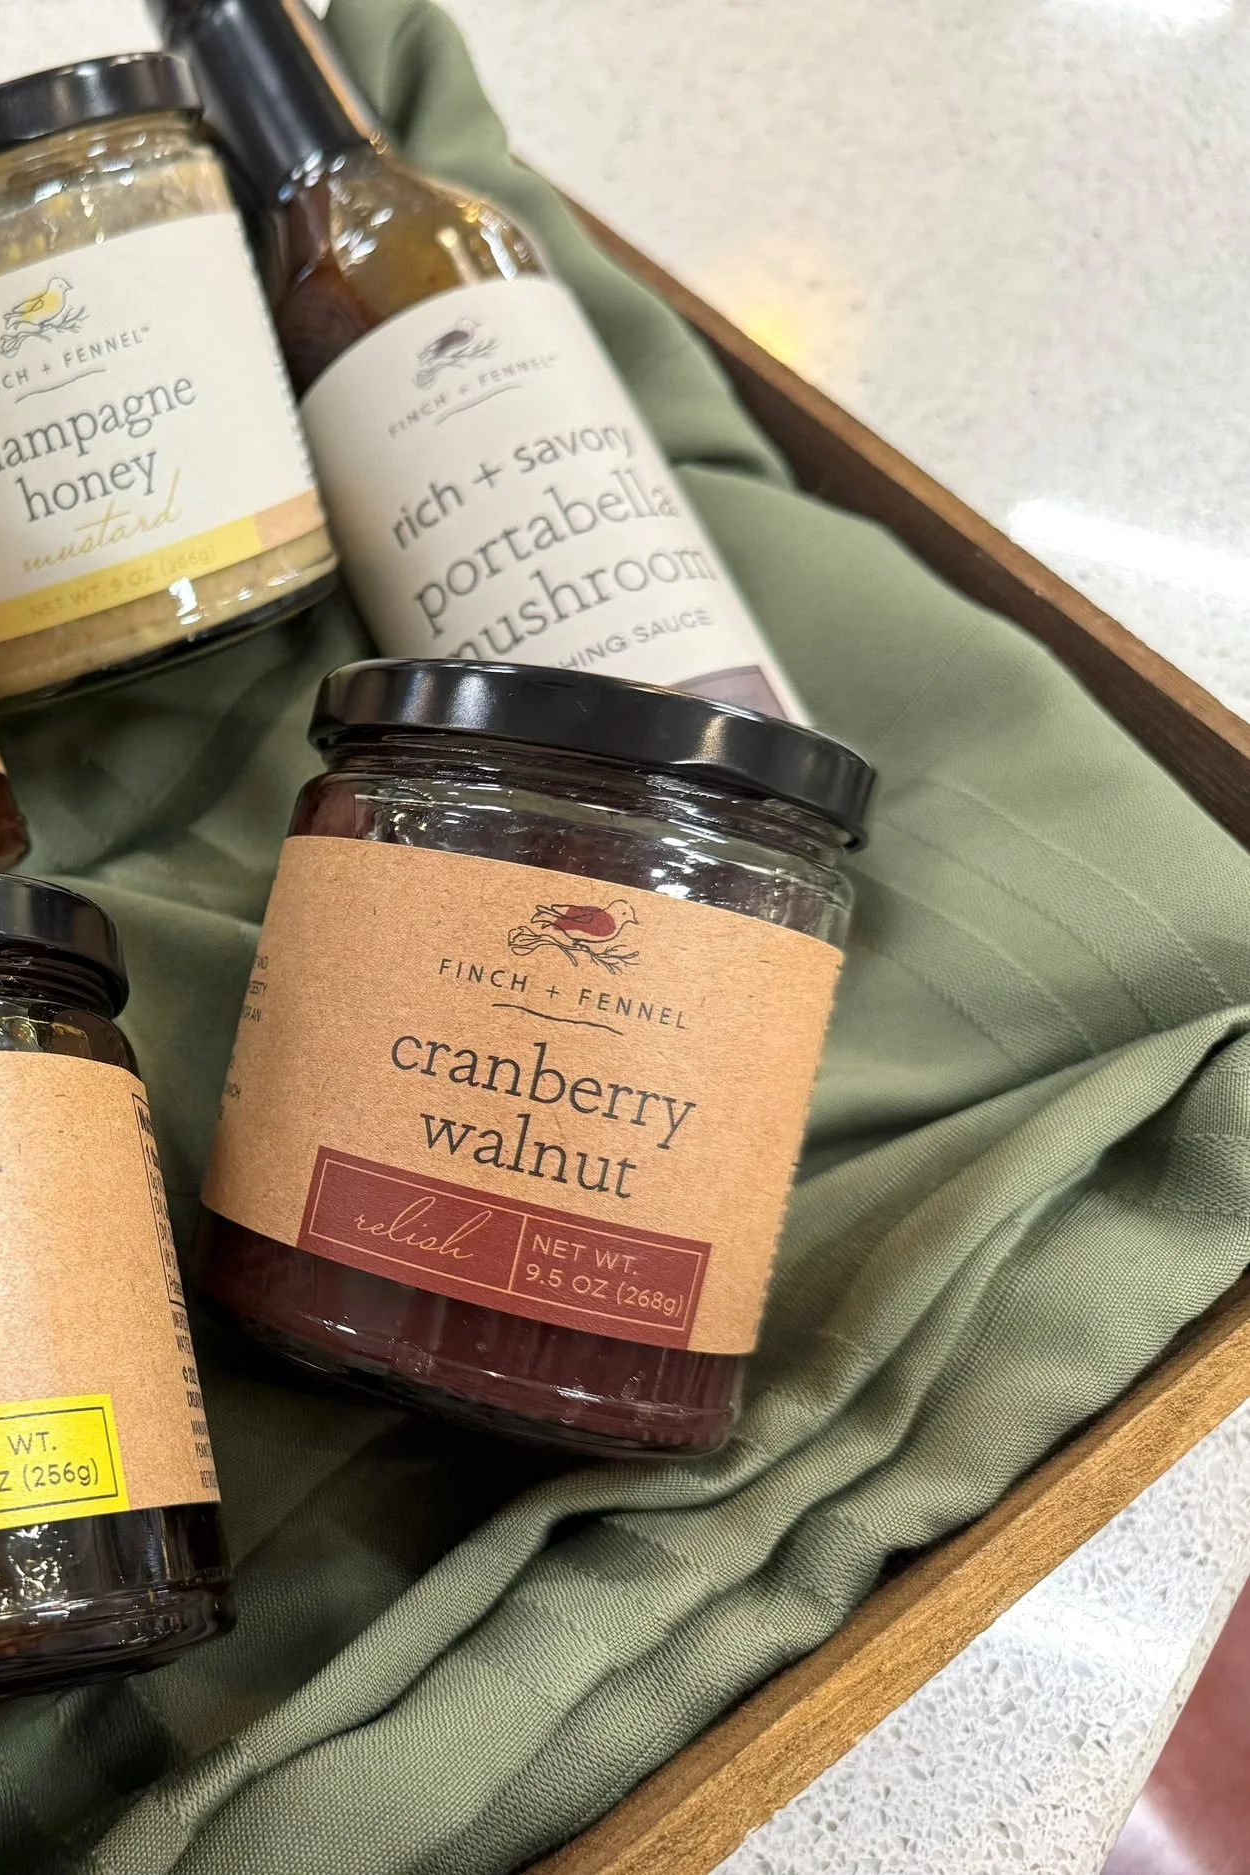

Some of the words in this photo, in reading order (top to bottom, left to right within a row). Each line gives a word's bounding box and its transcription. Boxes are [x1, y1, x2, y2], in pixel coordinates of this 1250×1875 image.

[16, 450, 158, 523] honey
[21, 467, 183, 572] mustard
[391, 483, 466, 550] rich
[512, 424, 635, 474] savory
[412, 469, 680, 639] portabella
[29, 601, 65, 622] NET
[127, 567, 155, 587] OZ
[632, 609, 714, 643] SAUCE
[439, 958, 528, 994] FINCH
[578, 987, 688, 1030] FENNEL
[391, 1034, 696, 1150] cranberry
[419, 1112, 638, 1199] walnut
[352, 1196, 494, 1260] relish
[531, 1233, 584, 1261] NET
[595, 1250, 638, 1275] WT.
[526, 1262, 563, 1289] 9.5
[572, 1272, 610, 1298] OZ
[616, 1281, 685, 1317] (268g)
[7, 1432, 58, 1457] WT.
[22, 1458, 100, 1494] (256g)
